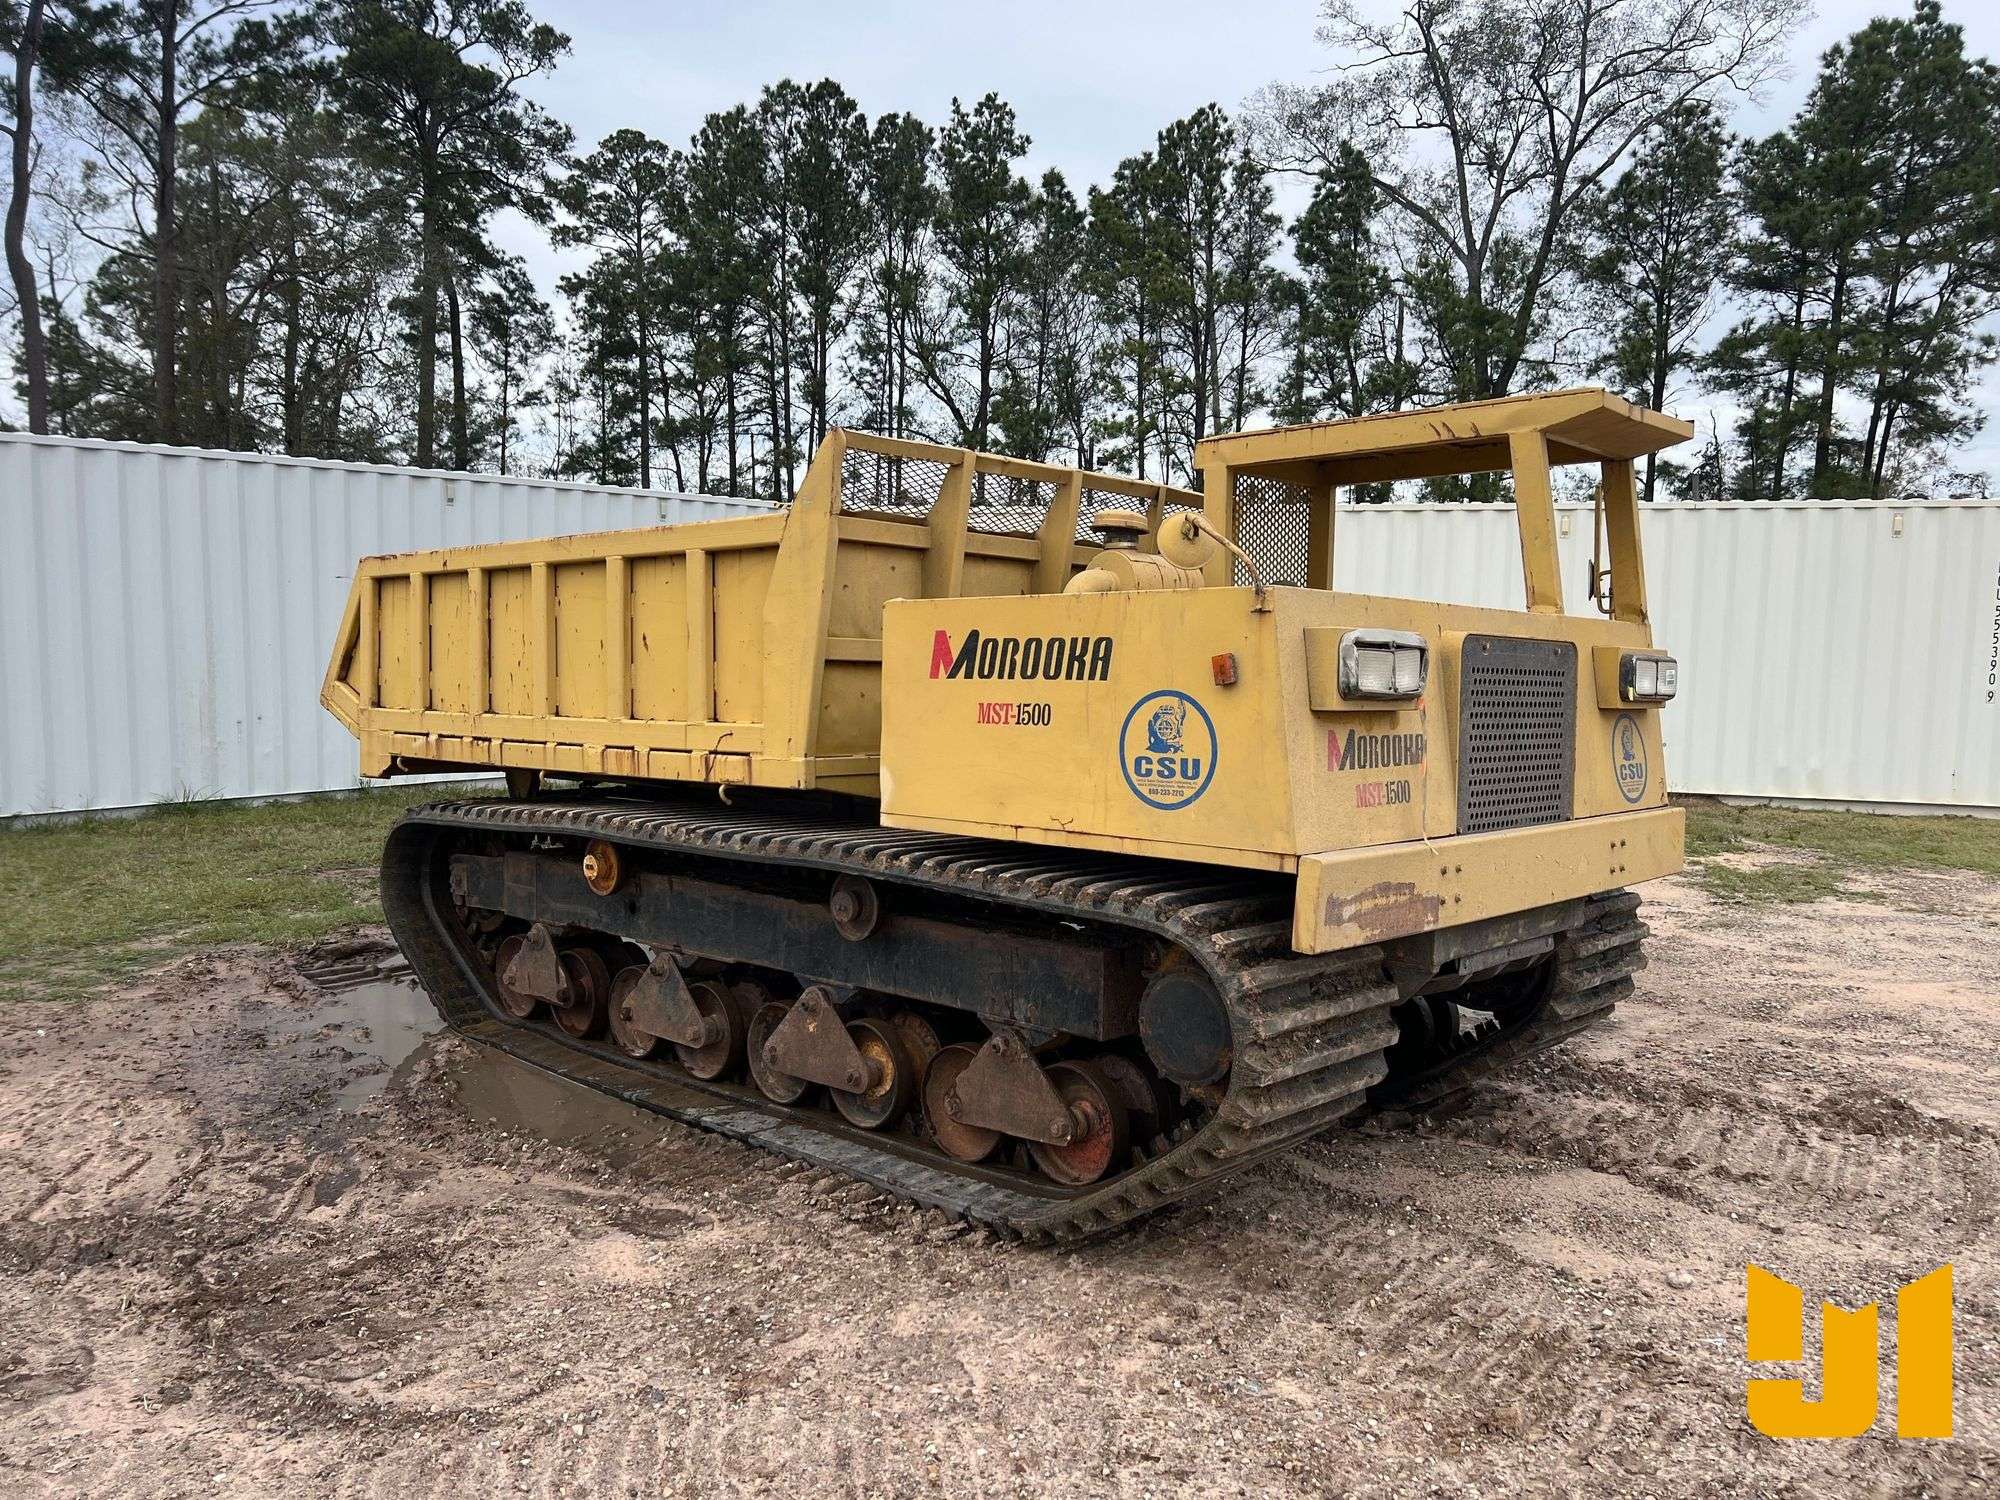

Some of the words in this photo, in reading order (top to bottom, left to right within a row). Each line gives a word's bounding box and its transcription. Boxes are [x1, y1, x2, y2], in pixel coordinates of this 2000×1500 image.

[929, 629, 1113, 681] MOROOKA
[977, 702, 1051, 726] MST-1500
[1327, 729, 1424, 772] MOROOKA
[1134, 756, 1201, 780] CSU
[1620, 763, 1643, 781] CSU
[1355, 780, 1411, 808] MST-1500
